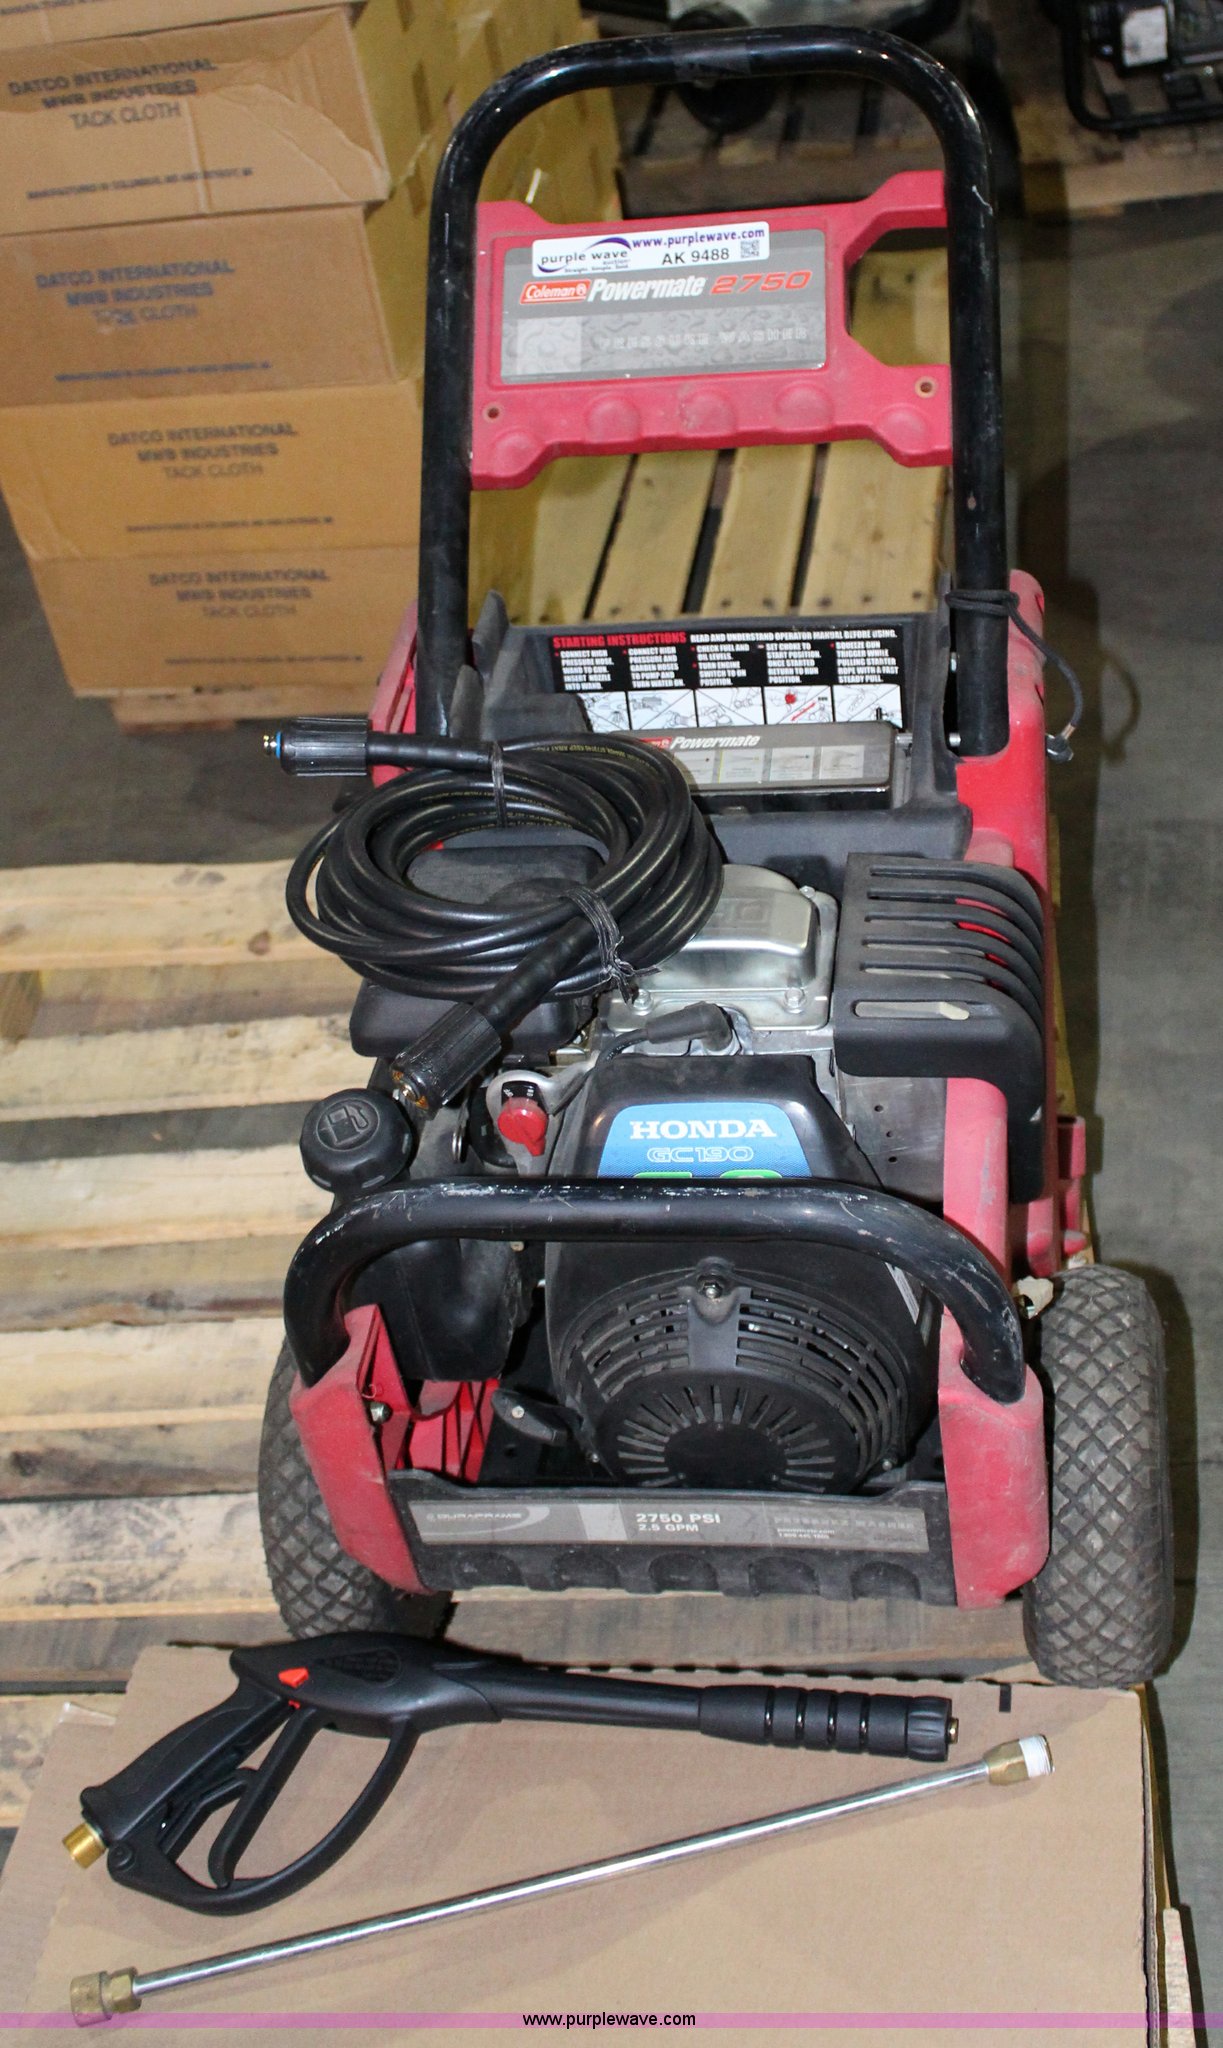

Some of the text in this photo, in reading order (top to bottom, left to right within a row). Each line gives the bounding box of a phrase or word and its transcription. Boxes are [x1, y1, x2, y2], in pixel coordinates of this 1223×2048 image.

[8, 58, 218, 96] DATCO INTERNATIONAL
[90, 79, 197, 103] INDUSTRIES
[69, 101, 181, 130] TACK CLOTH
[632, 228, 765, 248] www.purplewave.com
[541, 249, 628, 266] purple wave
[662, 247, 730, 266] AK 9488
[35, 260, 235, 289] DATCO INTERNATIONAL
[112, 281, 214, 302] INDUSTRIES
[525, 269, 812, 303] Coleman Powermate 2750
[140, 303, 197, 322] CLOTH
[107, 422, 297, 447] DATCO INTERNATIONAL
[181, 441, 279, 460] INDUSTRIES
[163, 461, 263, 479] TACK CLOTH
[149, 568, 330, 587] DATCO INTERNATIONAL
[218, 585, 312, 600] INDUSTRIES
[242, 603, 297, 619] CLOTH
[553, 631, 687, 650] STARTING INSTRUCTIONS
[690, 634, 709, 643] READ
[710, 633, 726, 643] AND
[726, 632, 774, 642] UNDERSTAND
[775, 631, 812, 641] OPERATOR
[813, 631, 843, 640] MANUAL
[843, 630, 871, 639] BEFORE
[801, 642, 811, 650] TO
[865, 640, 881, 649] GUN
[628, 647, 659, 656] CONNECT
[696, 644, 719, 653] CHECK
[735, 643, 750, 652] AND
[856, 666, 876, 674] WITH
[876, 666, 882, 674] A
[670, 734, 760, 750] Powermate
[629, 1119, 777, 1140] HONDA
[647, 1145, 755, 1164] GC190
[636, 1512, 721, 1524] 2750 PSI
[639, 1523, 699, 1532] 2.5 GPM
